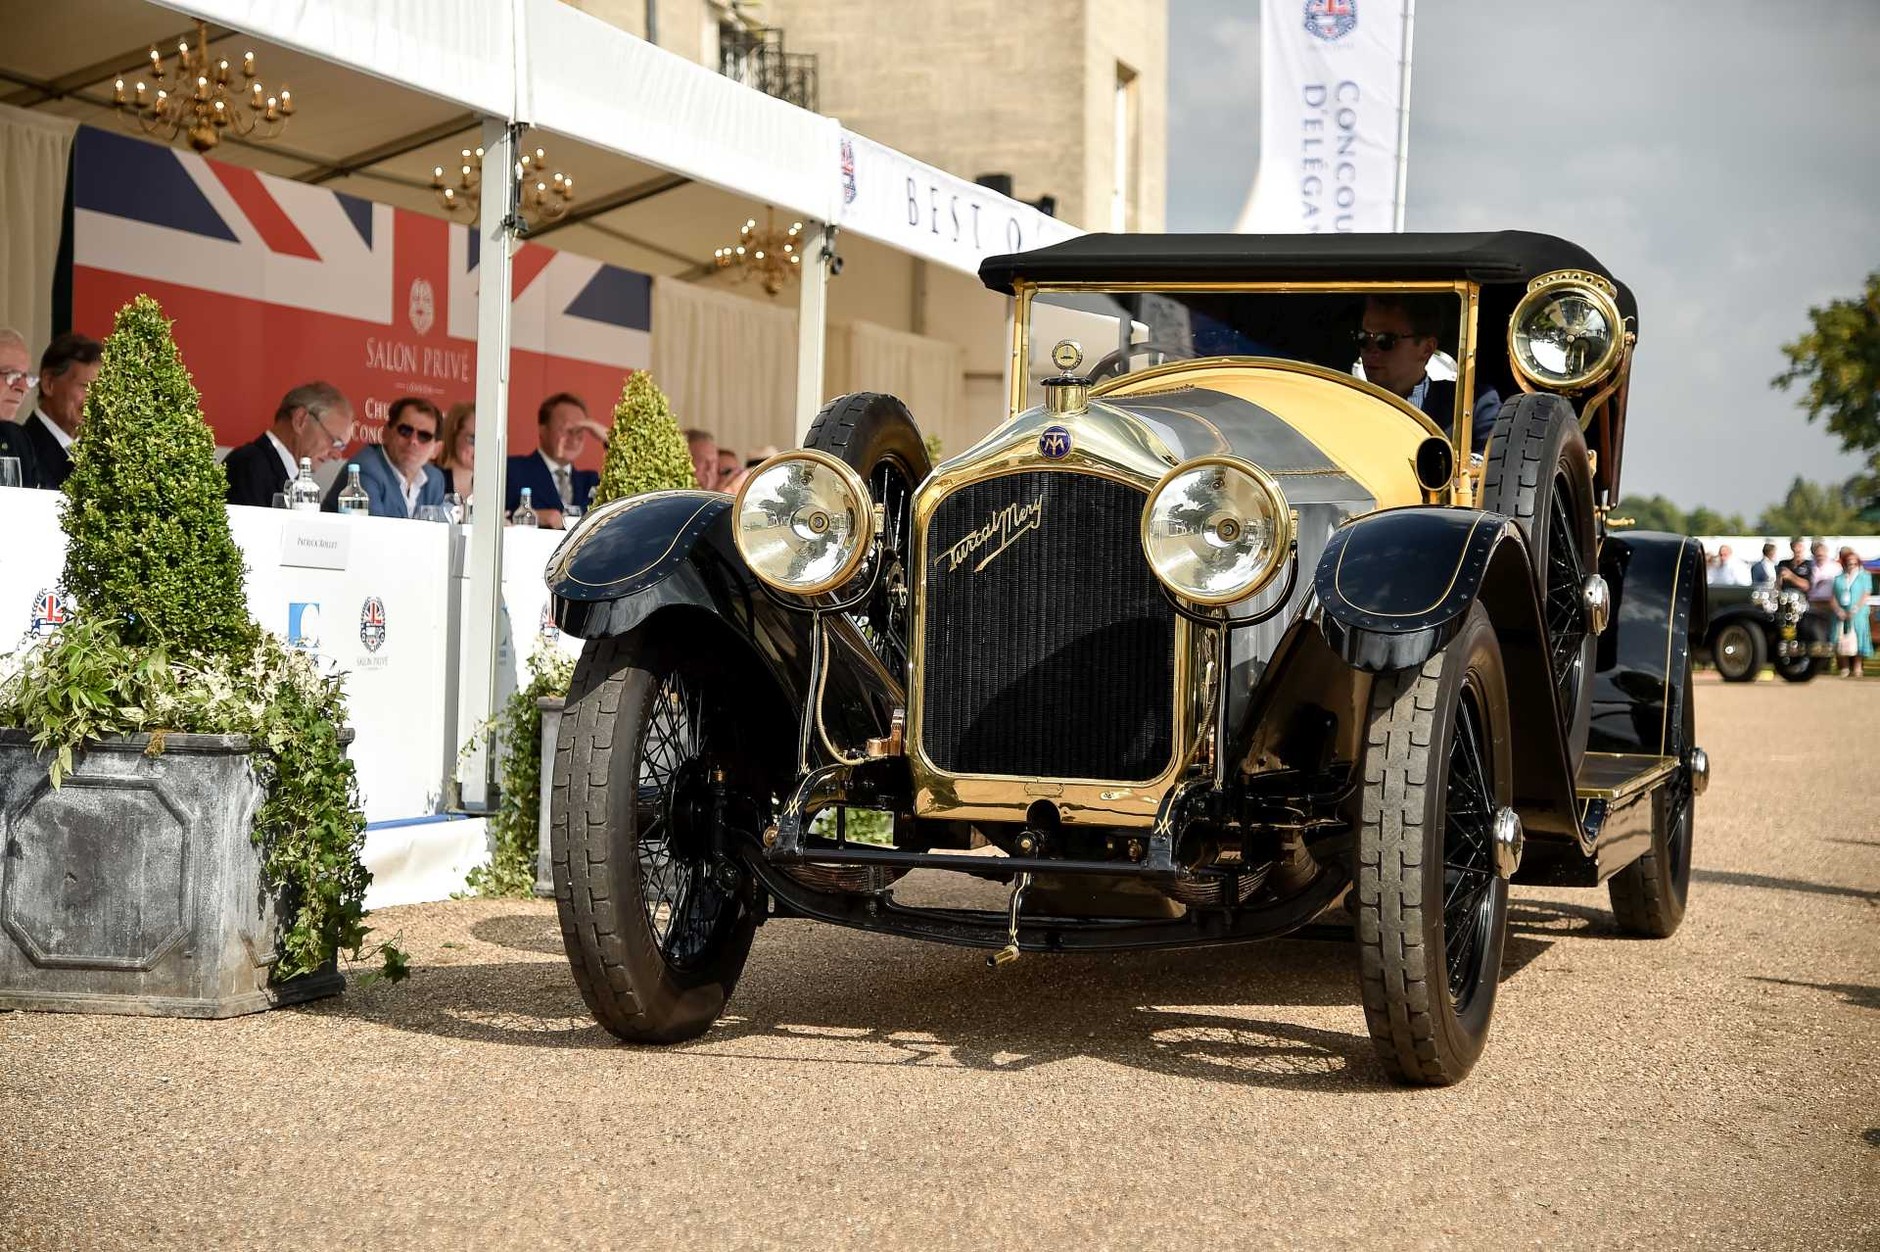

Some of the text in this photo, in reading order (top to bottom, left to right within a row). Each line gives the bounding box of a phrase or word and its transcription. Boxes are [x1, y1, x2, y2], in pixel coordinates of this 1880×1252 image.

[1336, 80, 1360, 232] CONCOU
[906, 177, 981, 249] BEST
[366, 336, 470, 383] SALON PRIVÉ
